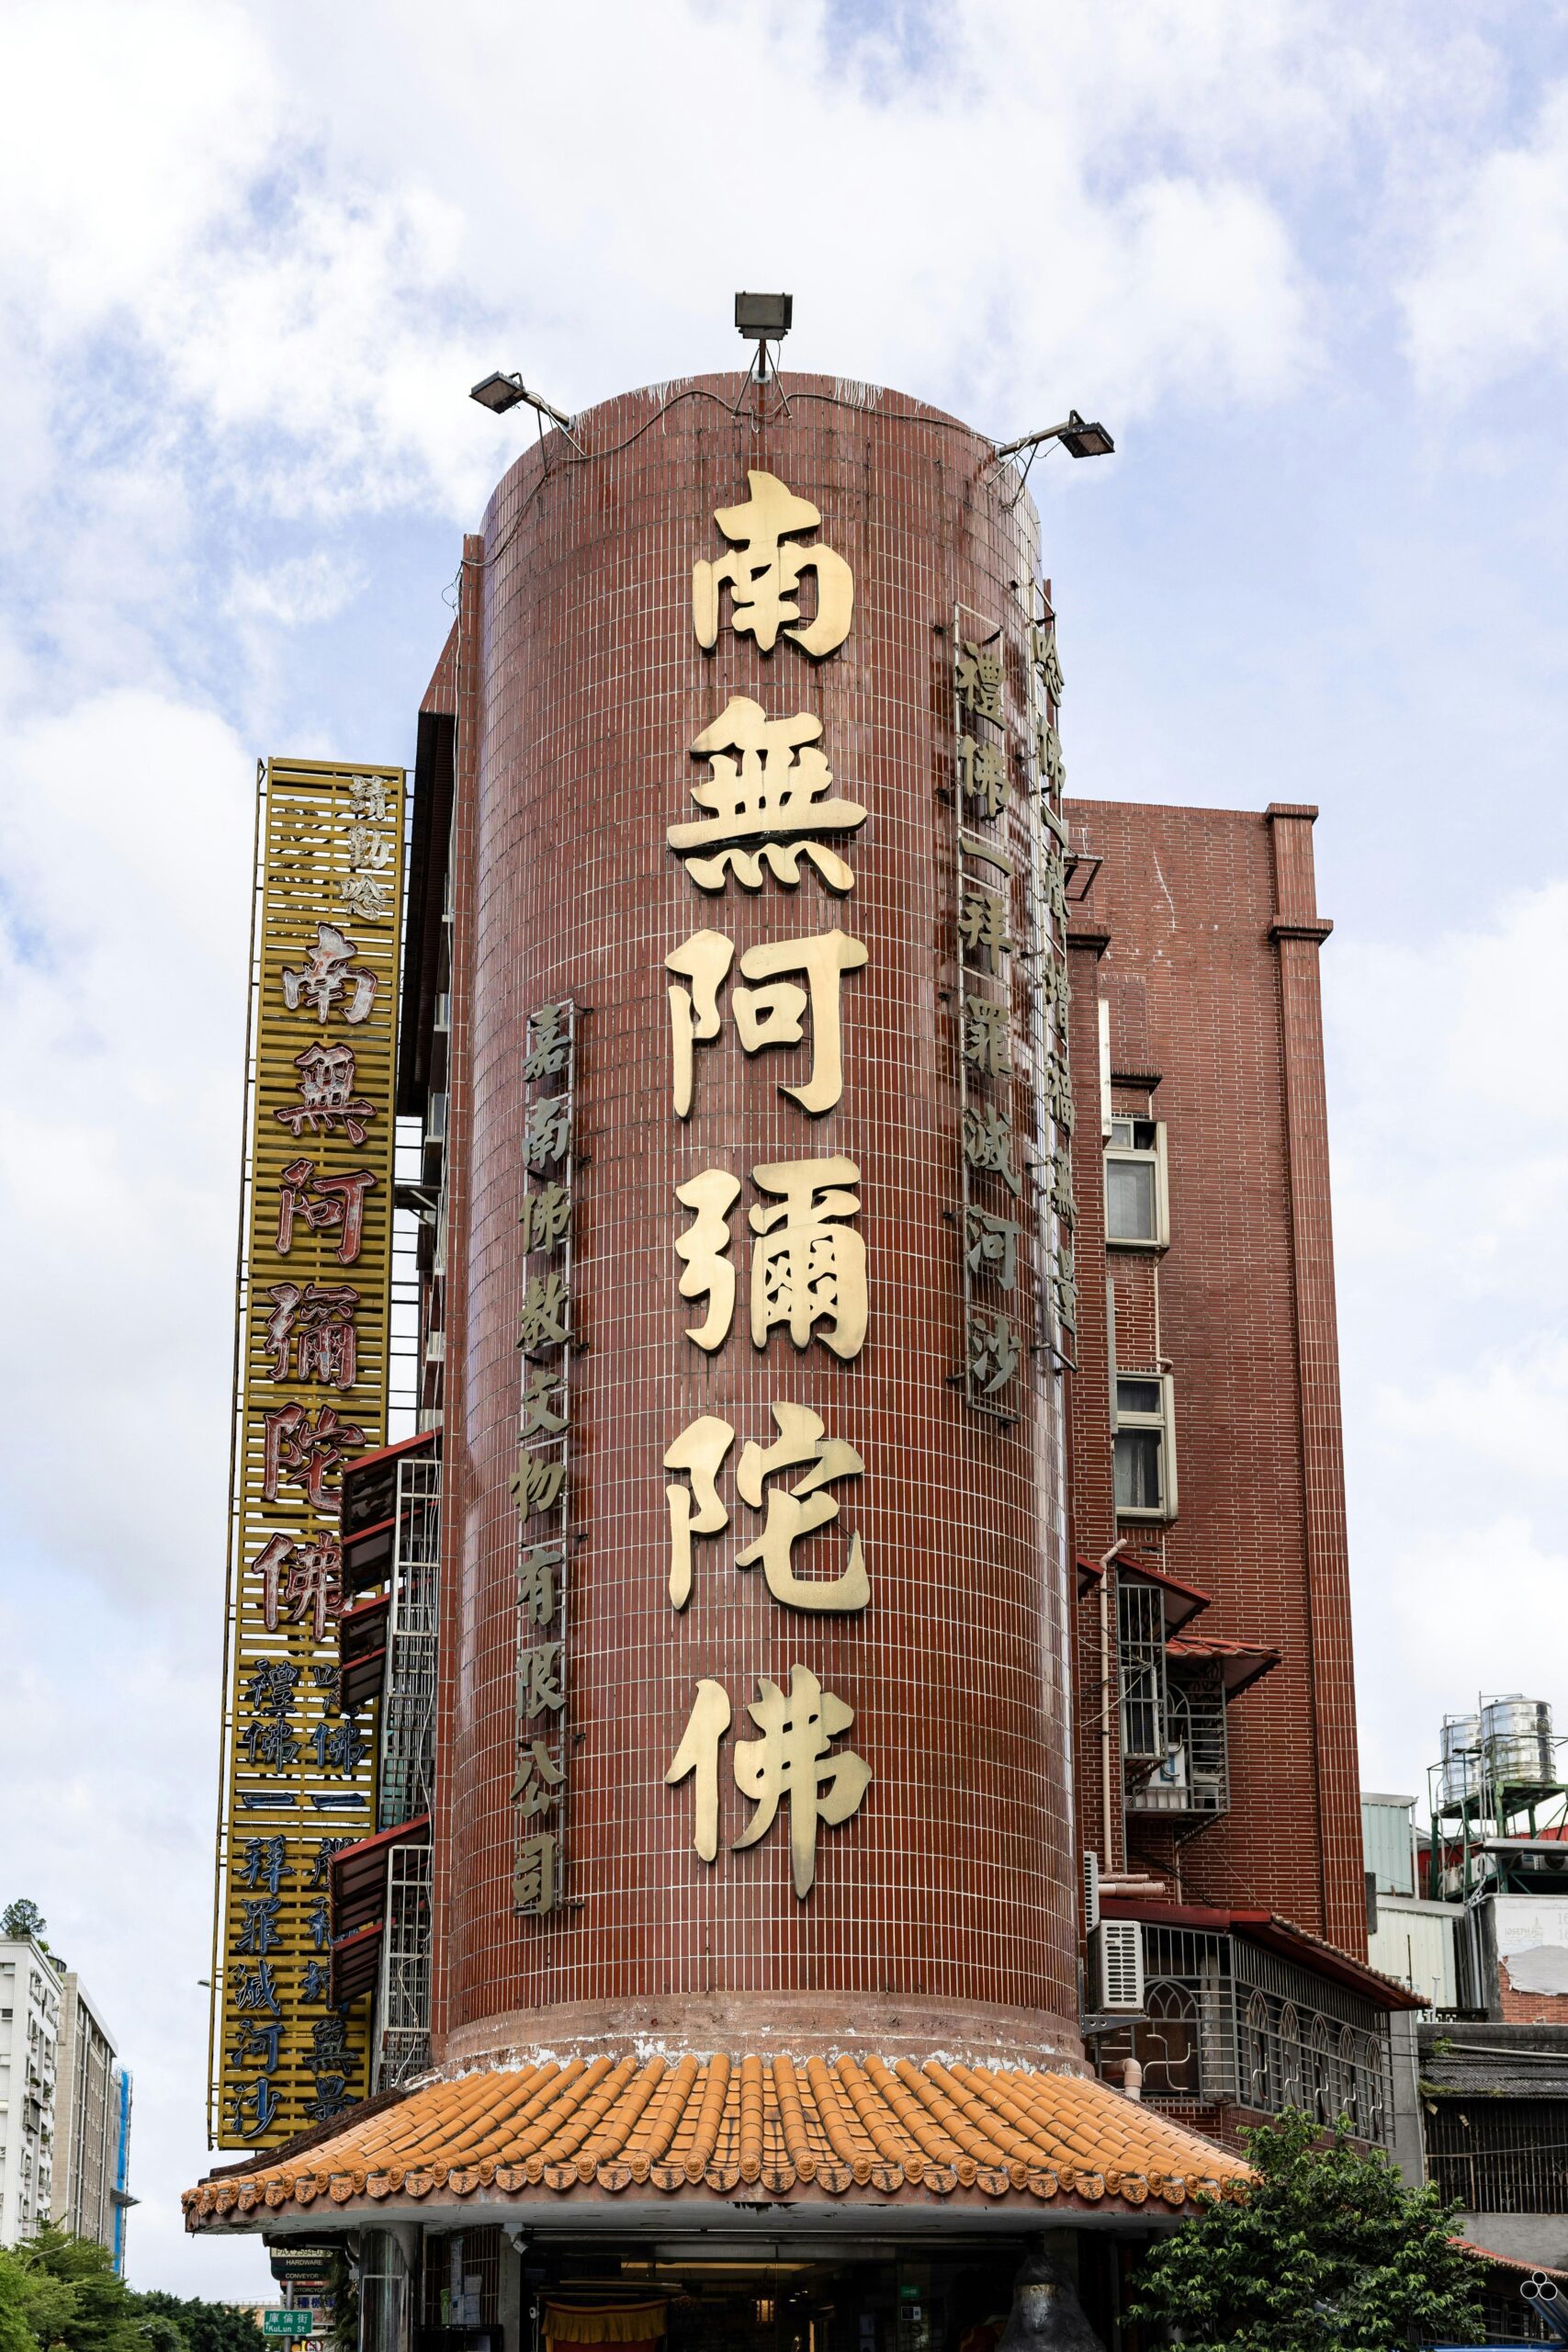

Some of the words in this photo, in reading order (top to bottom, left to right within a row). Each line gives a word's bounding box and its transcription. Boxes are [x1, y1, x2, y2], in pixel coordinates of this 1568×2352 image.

[251, 922, 379, 1643] 南無阿彌陀佛
[664, 469, 872, 1900] 南無阿彌陀佛
[955, 640, 1022, 1394] 禮佛一拜罪滅河沙
[509, 1003, 575, 1917] 嘉南佛教文物有限公司
[231, 1657, 303, 2140] 禮佛一拜罪滅河沙
[268, 2312, 309, 2324] 庫倫街
